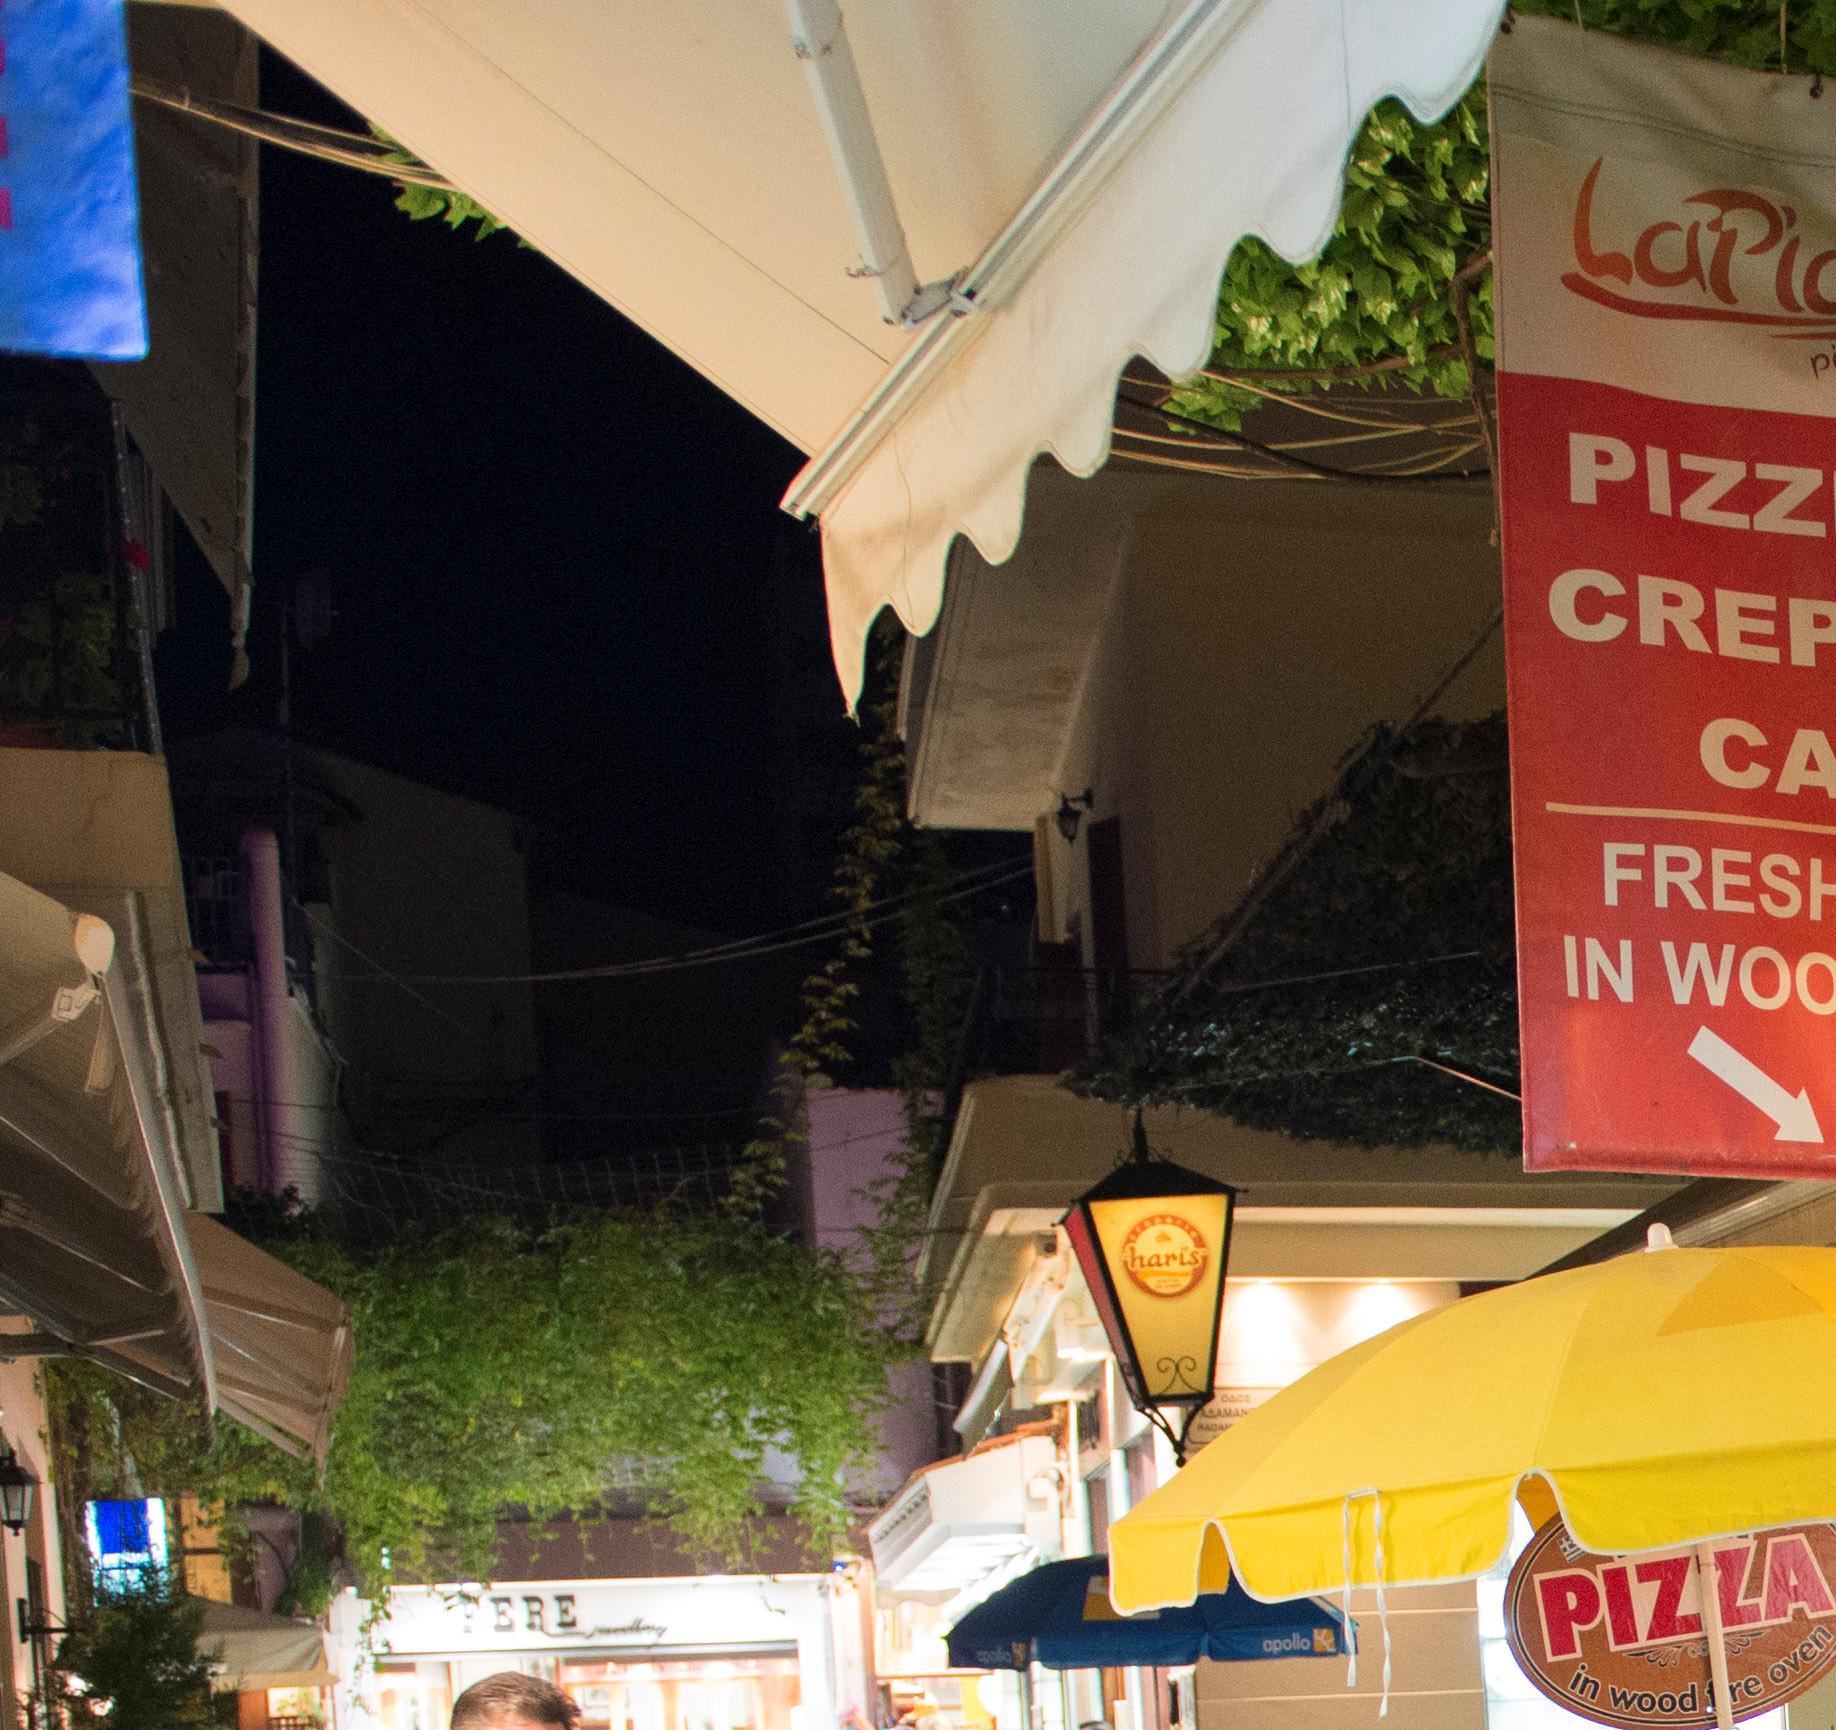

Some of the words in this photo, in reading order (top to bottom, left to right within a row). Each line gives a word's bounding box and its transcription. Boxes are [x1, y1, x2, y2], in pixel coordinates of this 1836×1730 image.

[1563, 934, 1634, 1004] IN
[1535, 1534, 1836, 1661] PIZZA
[1263, 1632, 1311, 1655] apollo
[1568, 1664, 1600, 1701] in
[1611, 1684, 1698, 1714] wood
[1706, 1673, 1762, 1715] fre
[1769, 1624, 1834, 1688] oven
